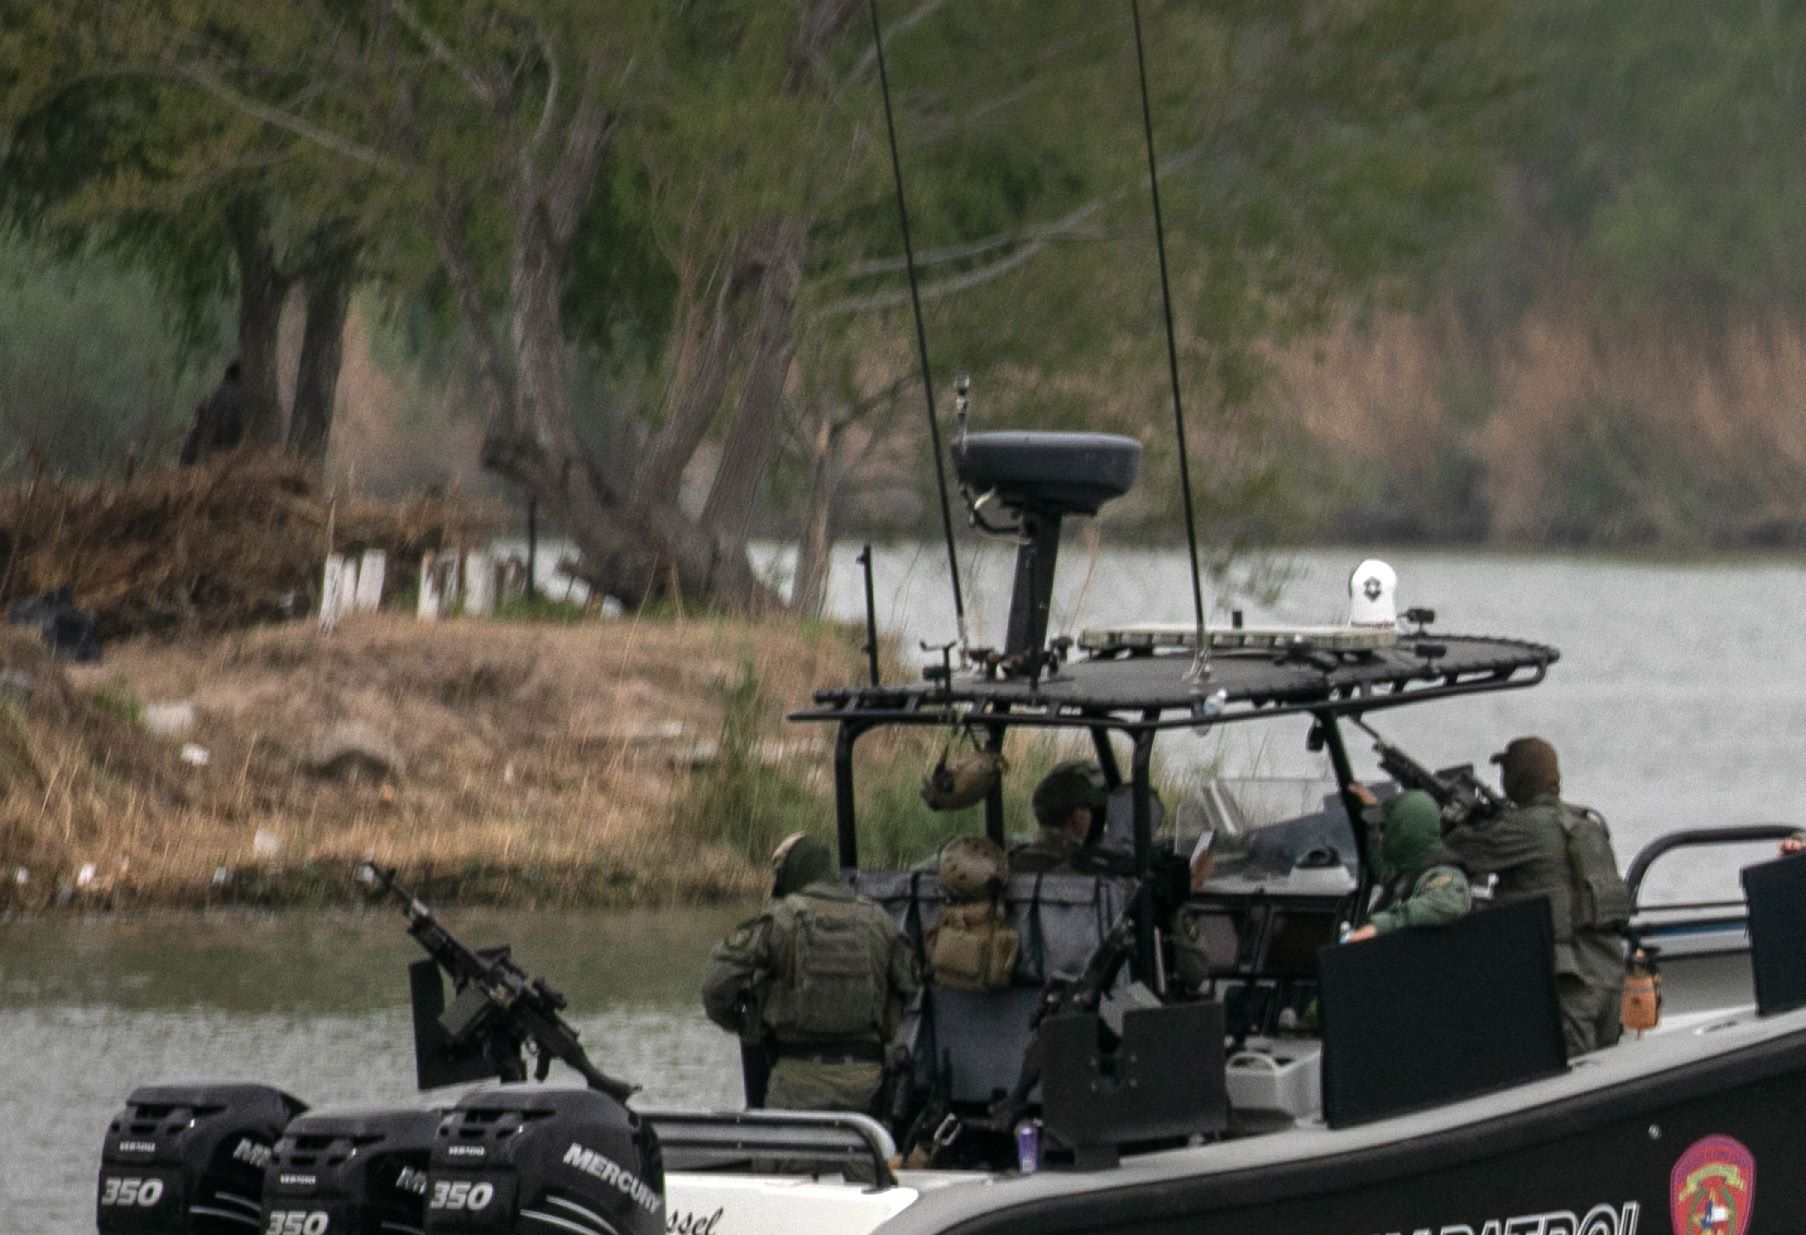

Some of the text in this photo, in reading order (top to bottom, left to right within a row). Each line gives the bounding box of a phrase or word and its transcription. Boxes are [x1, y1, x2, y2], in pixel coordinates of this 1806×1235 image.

[101, 1176, 164, 1207] 350
[562, 1141, 664, 1214] MERCURY
[430, 1180, 494, 1211] 350
